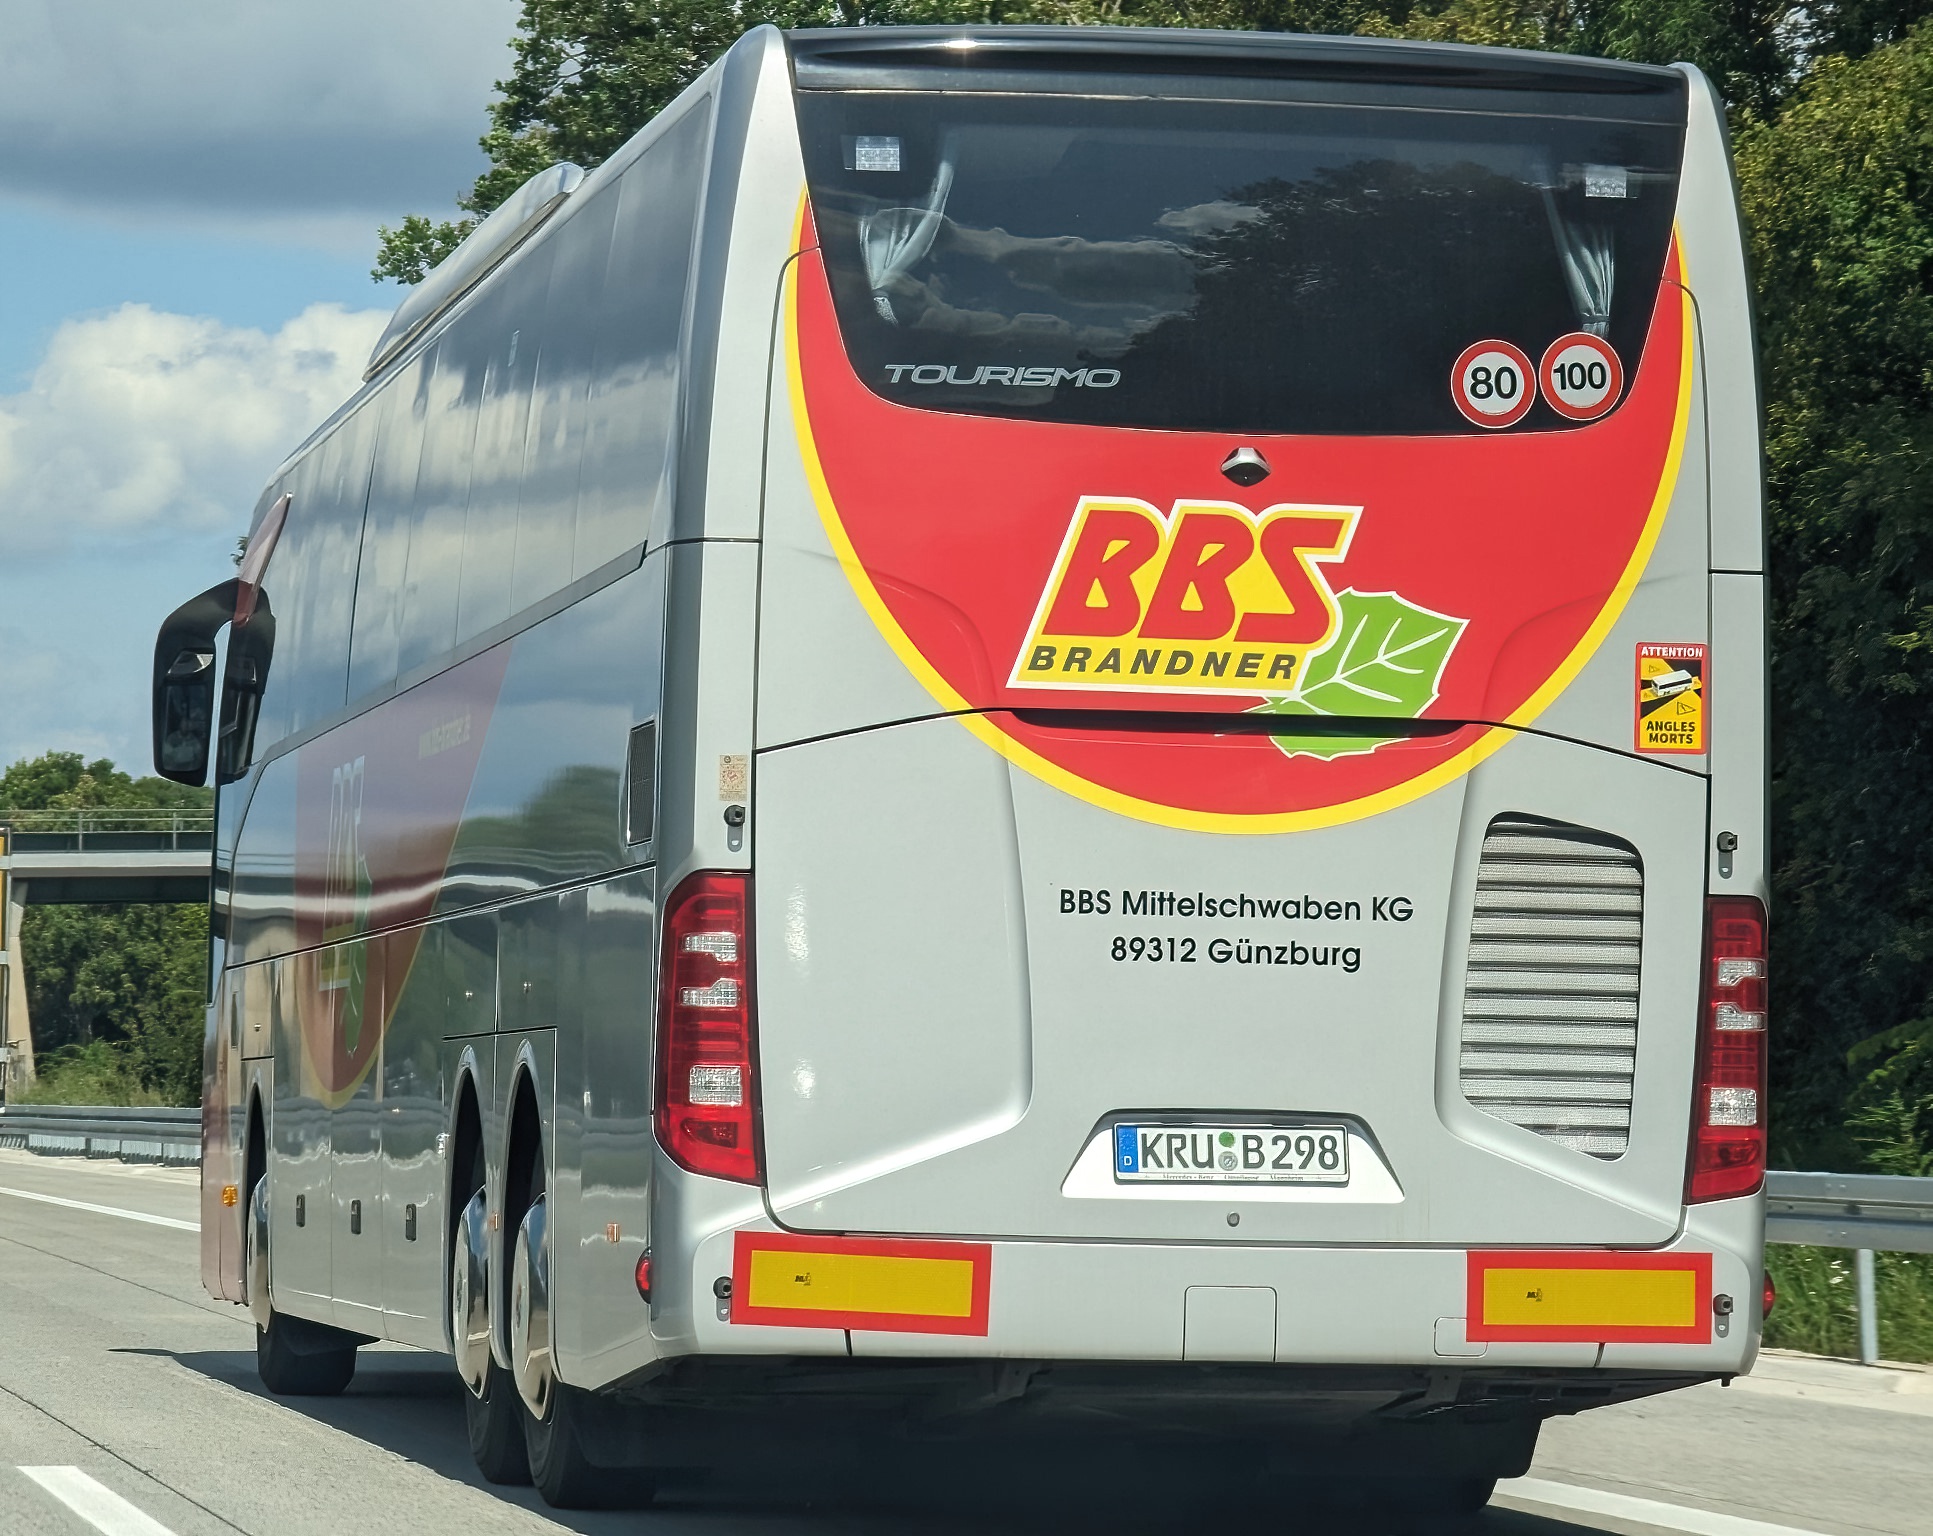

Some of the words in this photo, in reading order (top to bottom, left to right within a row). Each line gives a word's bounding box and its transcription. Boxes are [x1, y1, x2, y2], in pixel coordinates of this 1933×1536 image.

[884, 364, 1121, 388] TOURISMO
[1469, 366, 1517, 400] 80
[1553, 361, 1607, 391] 100
[1041, 509, 1346, 645] BBS
[1027, 645, 1297, 680] BRANDNER
[1641, 646, 1703, 658] ATTENTION
[1646, 720, 1696, 733] ANGLES
[1649, 732, 1693, 745] MORTS
[1060, 889, 1112, 915] BBS
[1122, 890, 1361, 921] Mittelschwaben
[1372, 896, 1414, 922] KG
[1111, 936, 1197, 963] 89312
[1207, 938, 1361, 974] Günzburg
[1123, 1155, 1133, 1166] D
[1140, 1133, 1215, 1169] KRU
